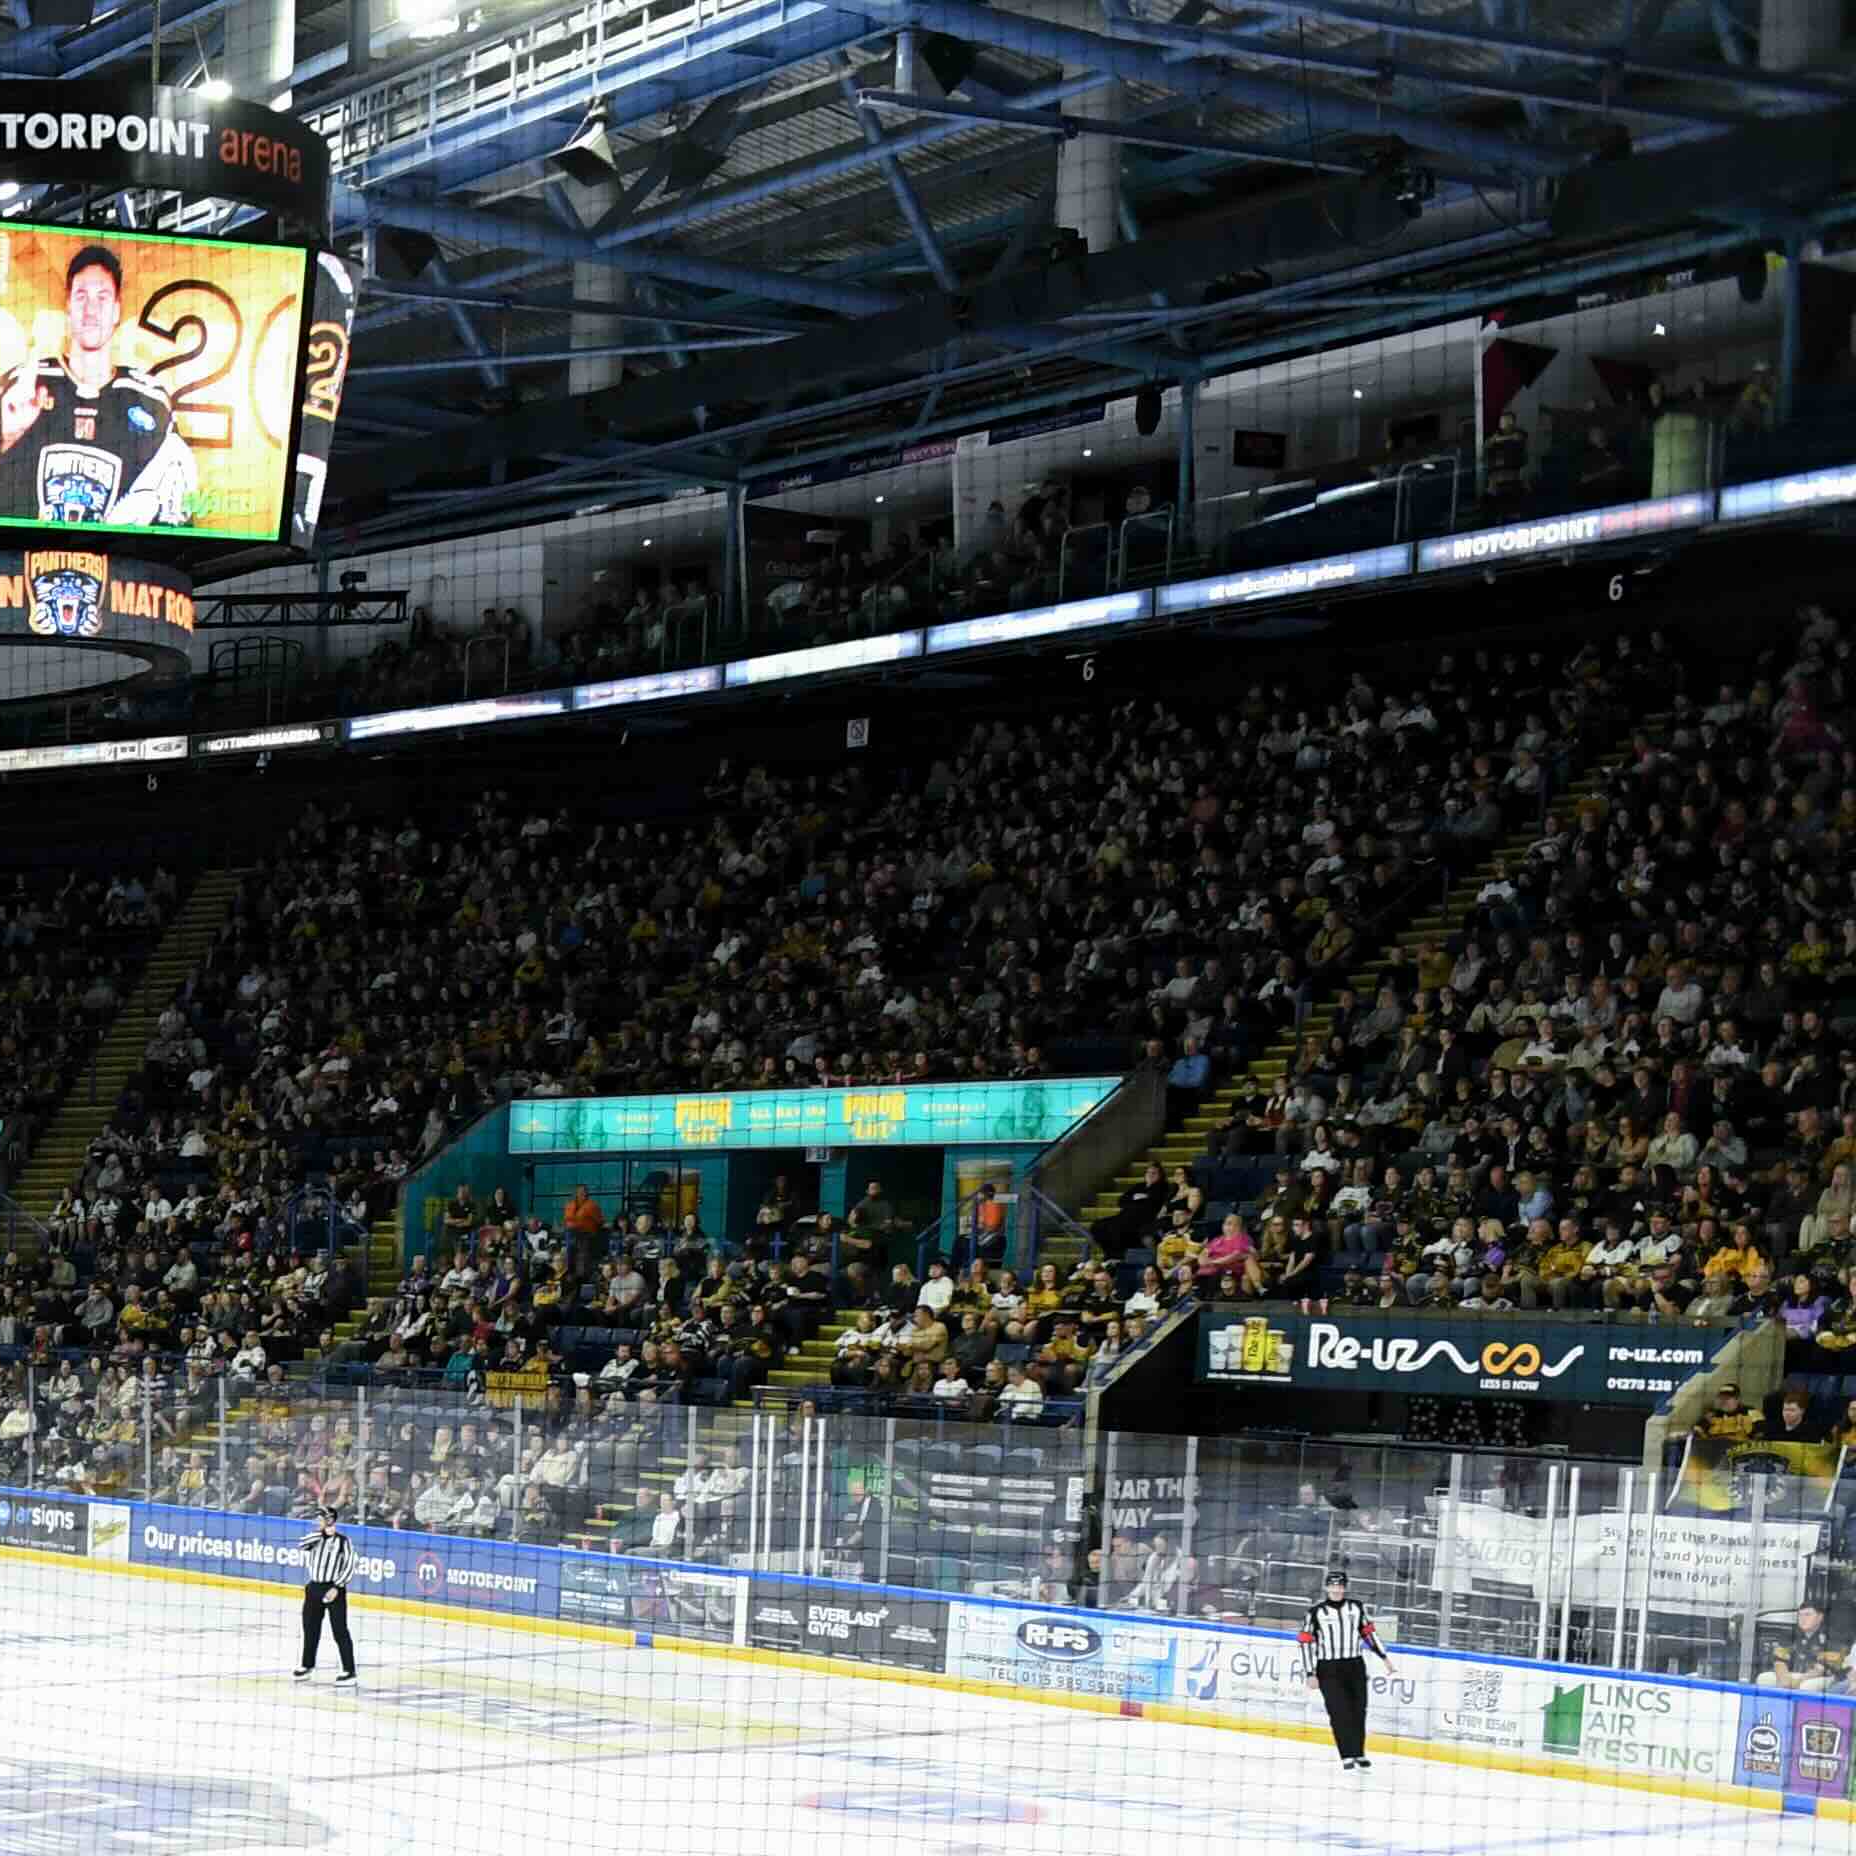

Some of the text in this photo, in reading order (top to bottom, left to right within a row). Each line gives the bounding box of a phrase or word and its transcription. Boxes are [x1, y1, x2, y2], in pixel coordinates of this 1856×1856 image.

[219, 127, 303, 183] arena
[1454, 514, 1600, 562] MOTORPOINT
[28, 550, 105, 575] PANTHERS
[1609, 575, 1624, 601] 6
[111, 580, 196, 633] MAT ROB
[1082, 659, 1095, 681] 6
[1609, 1346, 1704, 1364] re-uz.com
[1512, 1379, 1540, 1391] NOW
[143, 1526, 177, 1552] Our
[179, 1530, 233, 1557] prices
[235, 1539, 274, 1566] take
[1682, 1530, 1706, 1544] the
[1600, 1545, 1617, 1557] 25
[1663, 1551, 1691, 1563] and
[1695, 1553, 1733, 1567] your
[448, 1568, 537, 1594] MOTORPOINT
[1653, 1569, 1682, 1582] even
[809, 1604, 880, 1628] EVERLAST
[809, 1620, 849, 1640] GYMS
[1025, 1623, 1089, 1651] RHPS
[1230, 1651, 1280, 1681] GVL
[1589, 1682, 1672, 1714] LINCS
[1588, 1710, 1635, 1737] AIR
[1587, 1736, 1714, 1774] TESTING
